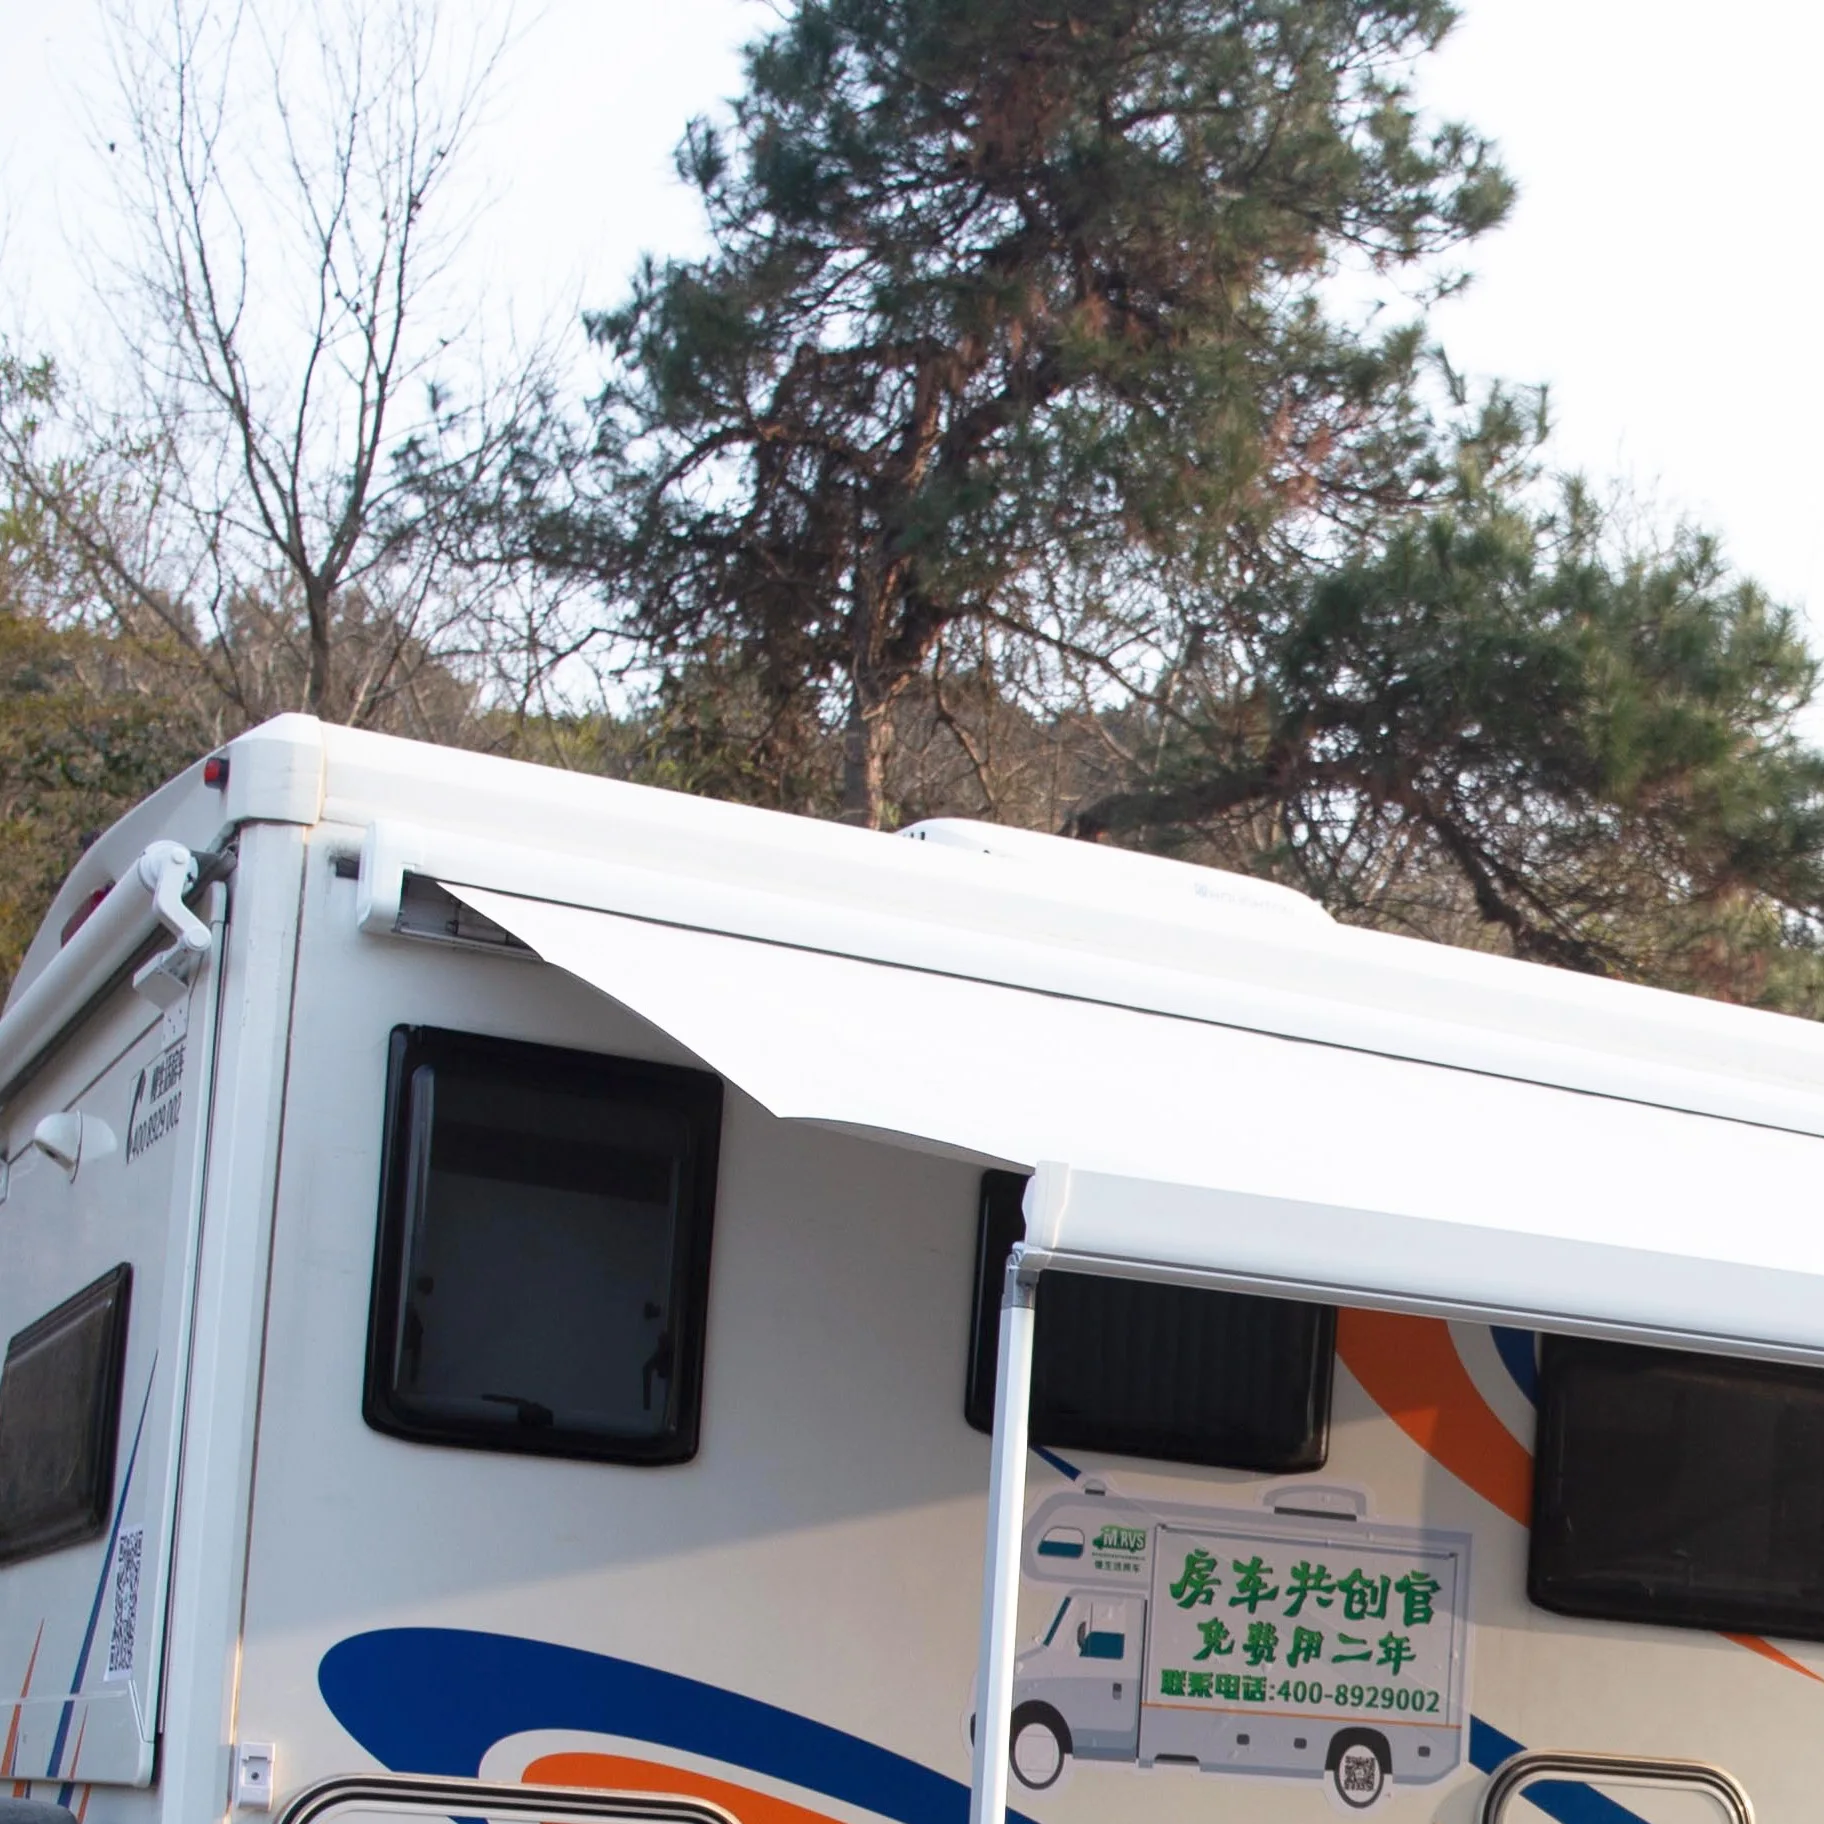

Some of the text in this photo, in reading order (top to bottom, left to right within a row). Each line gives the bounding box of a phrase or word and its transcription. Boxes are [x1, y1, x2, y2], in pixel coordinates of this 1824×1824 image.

[1169, 1548, 1441, 1627] 房车共创官
[1193, 1616, 1417, 1677] 免费用二年
